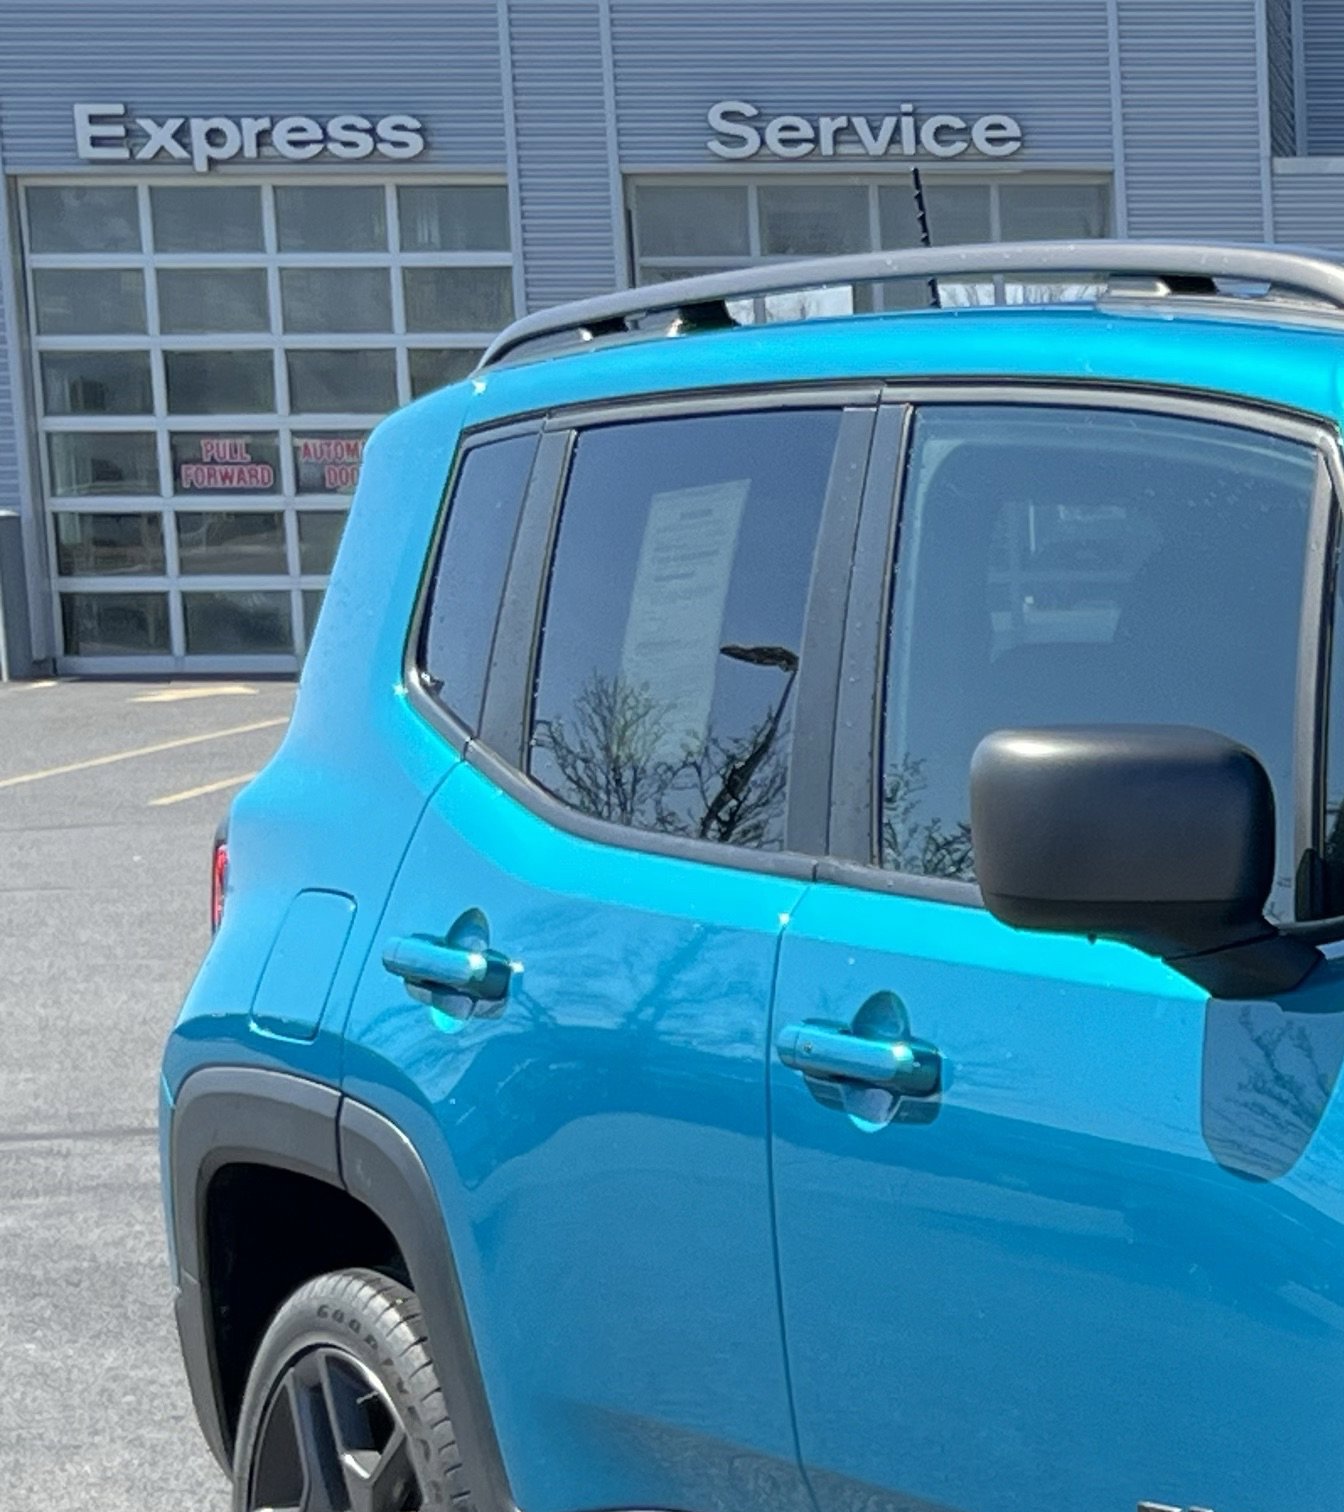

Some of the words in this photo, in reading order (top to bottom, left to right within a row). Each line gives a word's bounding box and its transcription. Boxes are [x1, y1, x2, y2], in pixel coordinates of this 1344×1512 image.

[73, 102, 427, 173] Express
[706, 100, 1024, 160] Service
[201, 438, 252, 462] PULL
[302, 439, 364, 462] AUTOM
[181, 464, 274, 489] FORWARD
[325, 465, 360, 488] DOO
